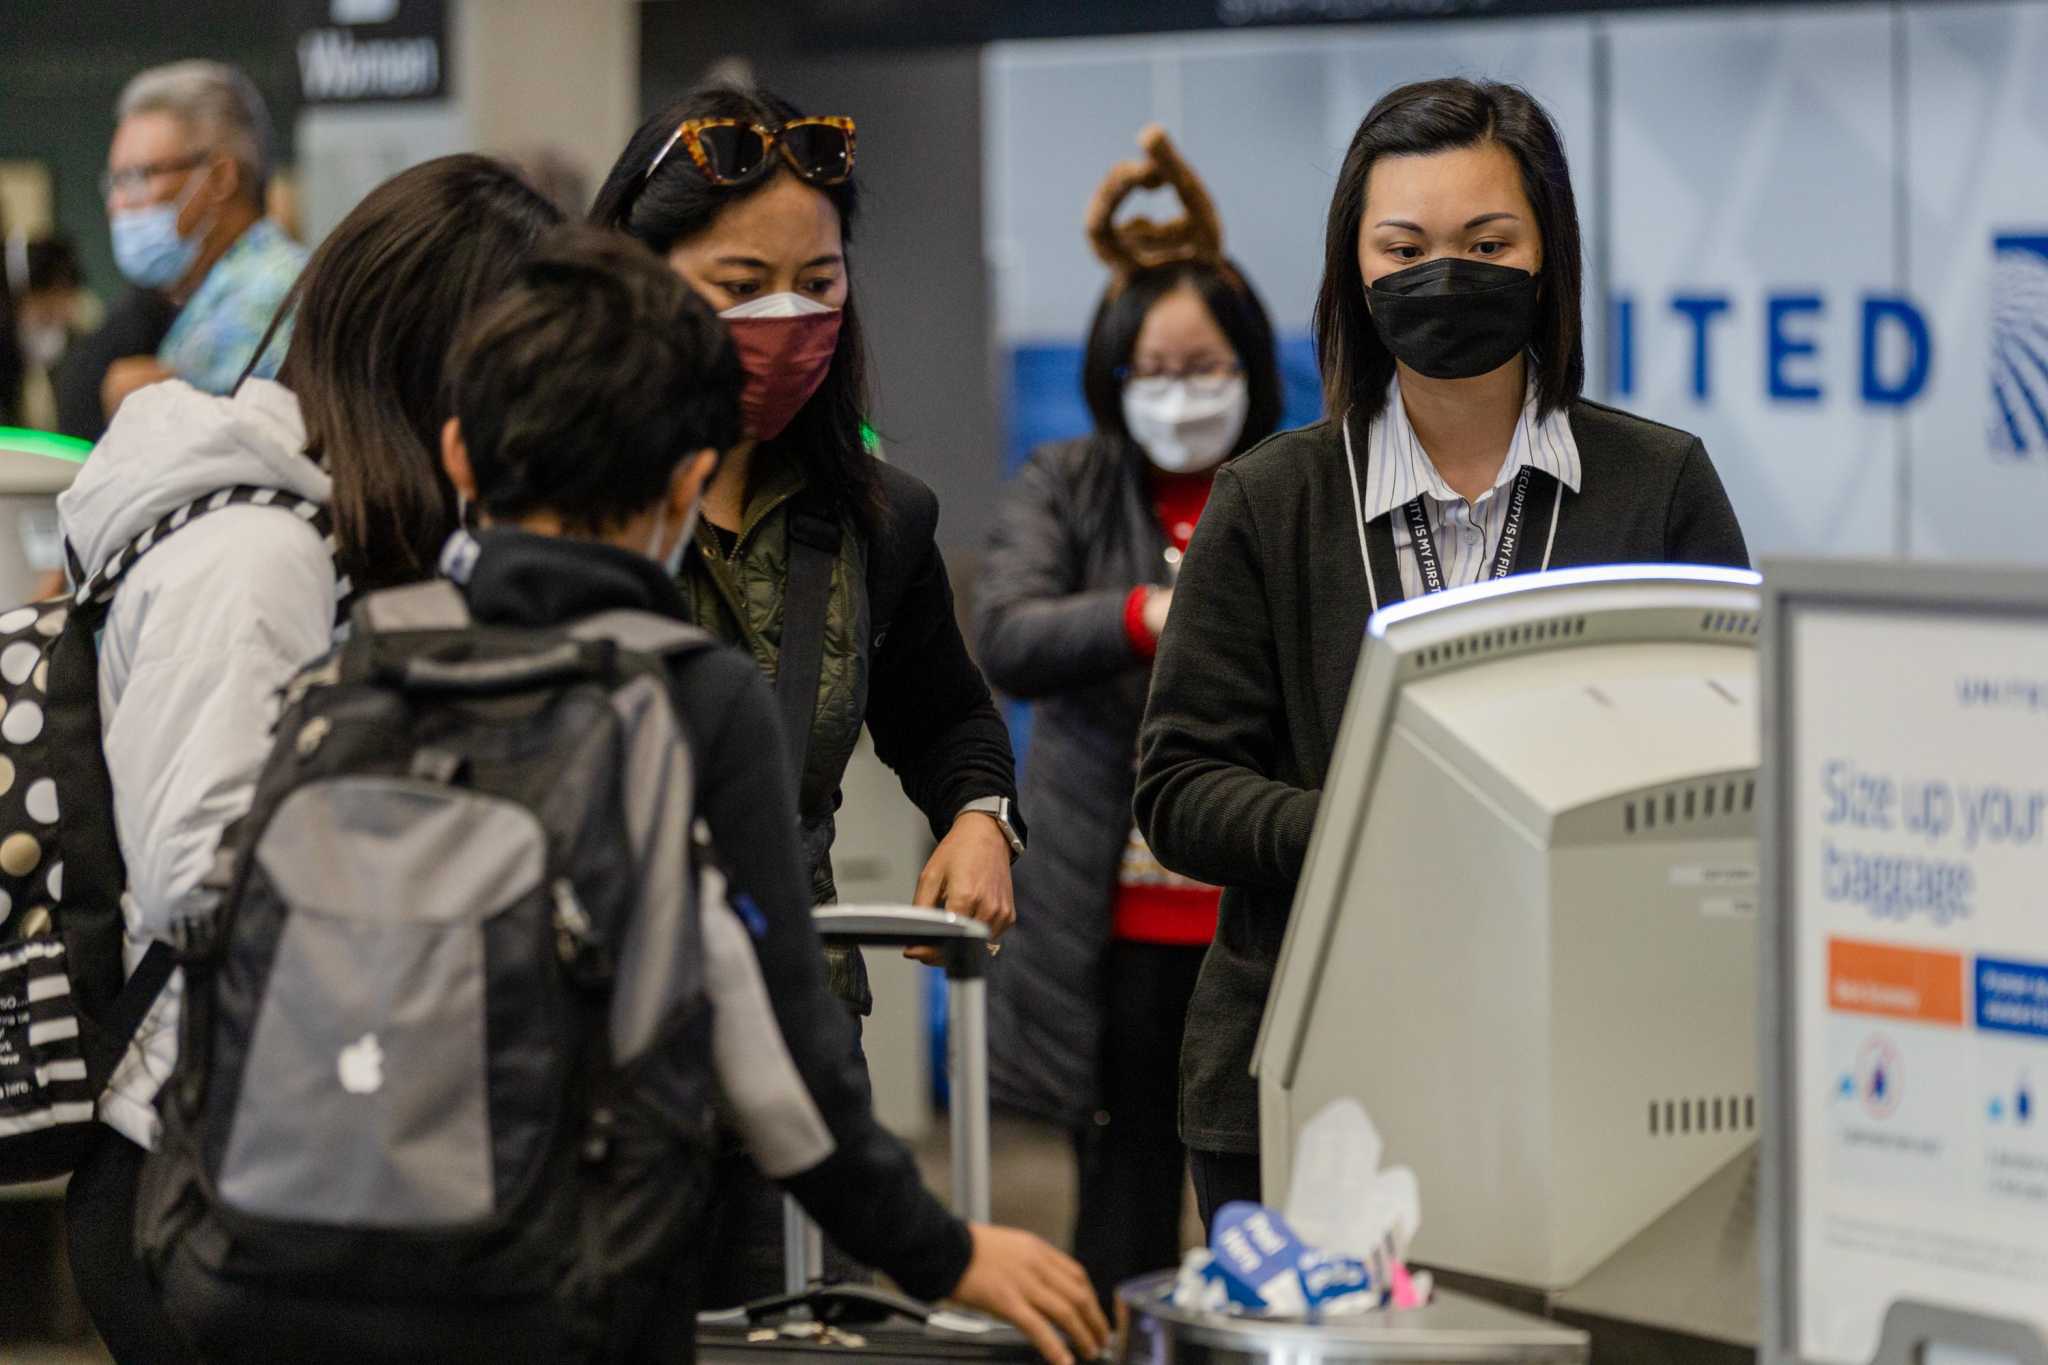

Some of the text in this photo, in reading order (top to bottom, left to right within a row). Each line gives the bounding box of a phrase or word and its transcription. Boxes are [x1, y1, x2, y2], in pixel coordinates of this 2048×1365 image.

[1610, 294, 1932, 404] ITED
[1415, 524, 1427, 538] IS
[1506, 521, 1517, 536] IS
[1418, 538, 1433, 557] MY
[1501, 536, 1514, 557] MY
[1495, 557, 1510, 579] FIR
[1822, 758, 2047, 852] Size up your
[1822, 840, 1975, 926] baggage
